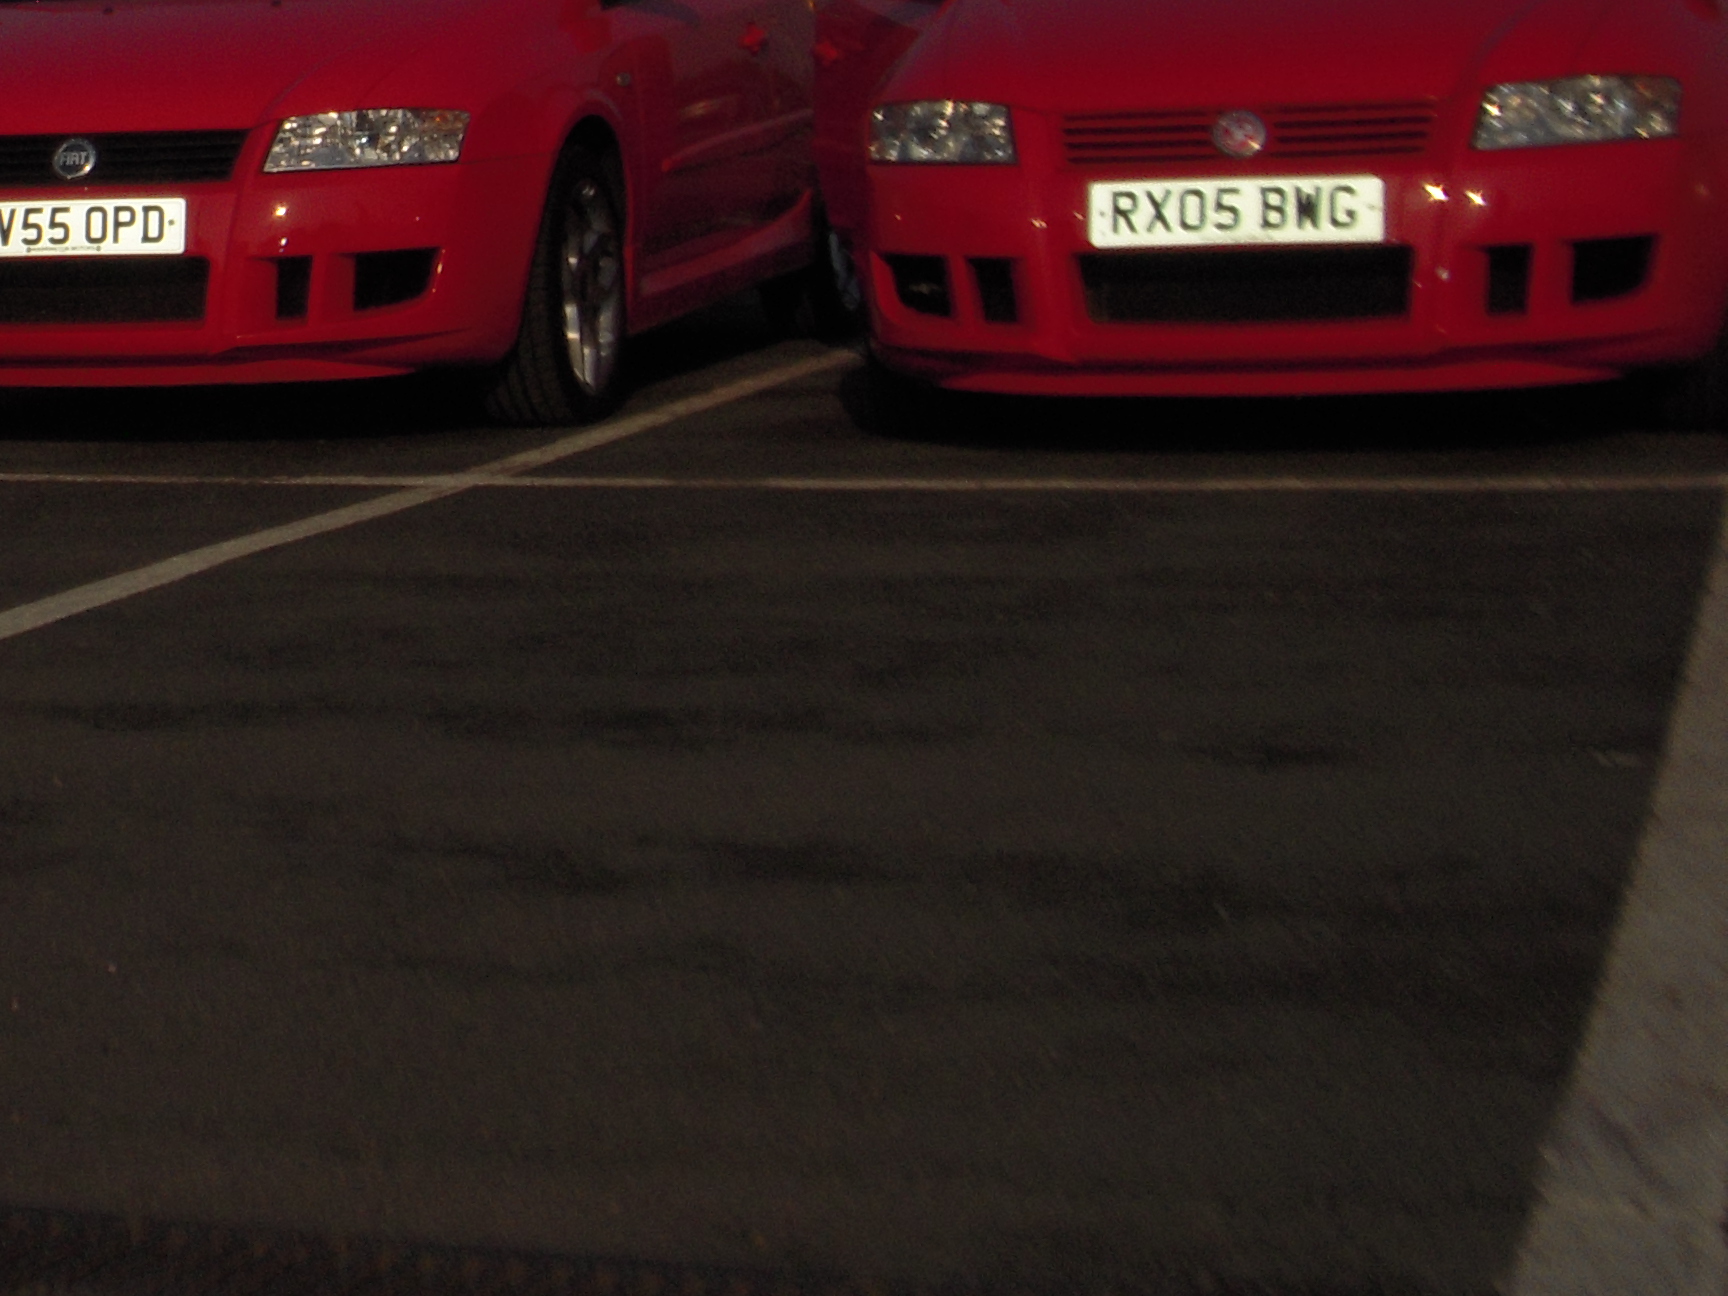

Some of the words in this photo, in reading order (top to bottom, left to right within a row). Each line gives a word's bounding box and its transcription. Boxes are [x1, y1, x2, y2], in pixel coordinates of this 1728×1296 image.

[85, 205, 166, 245] OPD
[1112, 187, 1241, 234] RX05
[1260, 185, 1357, 230] BWG
